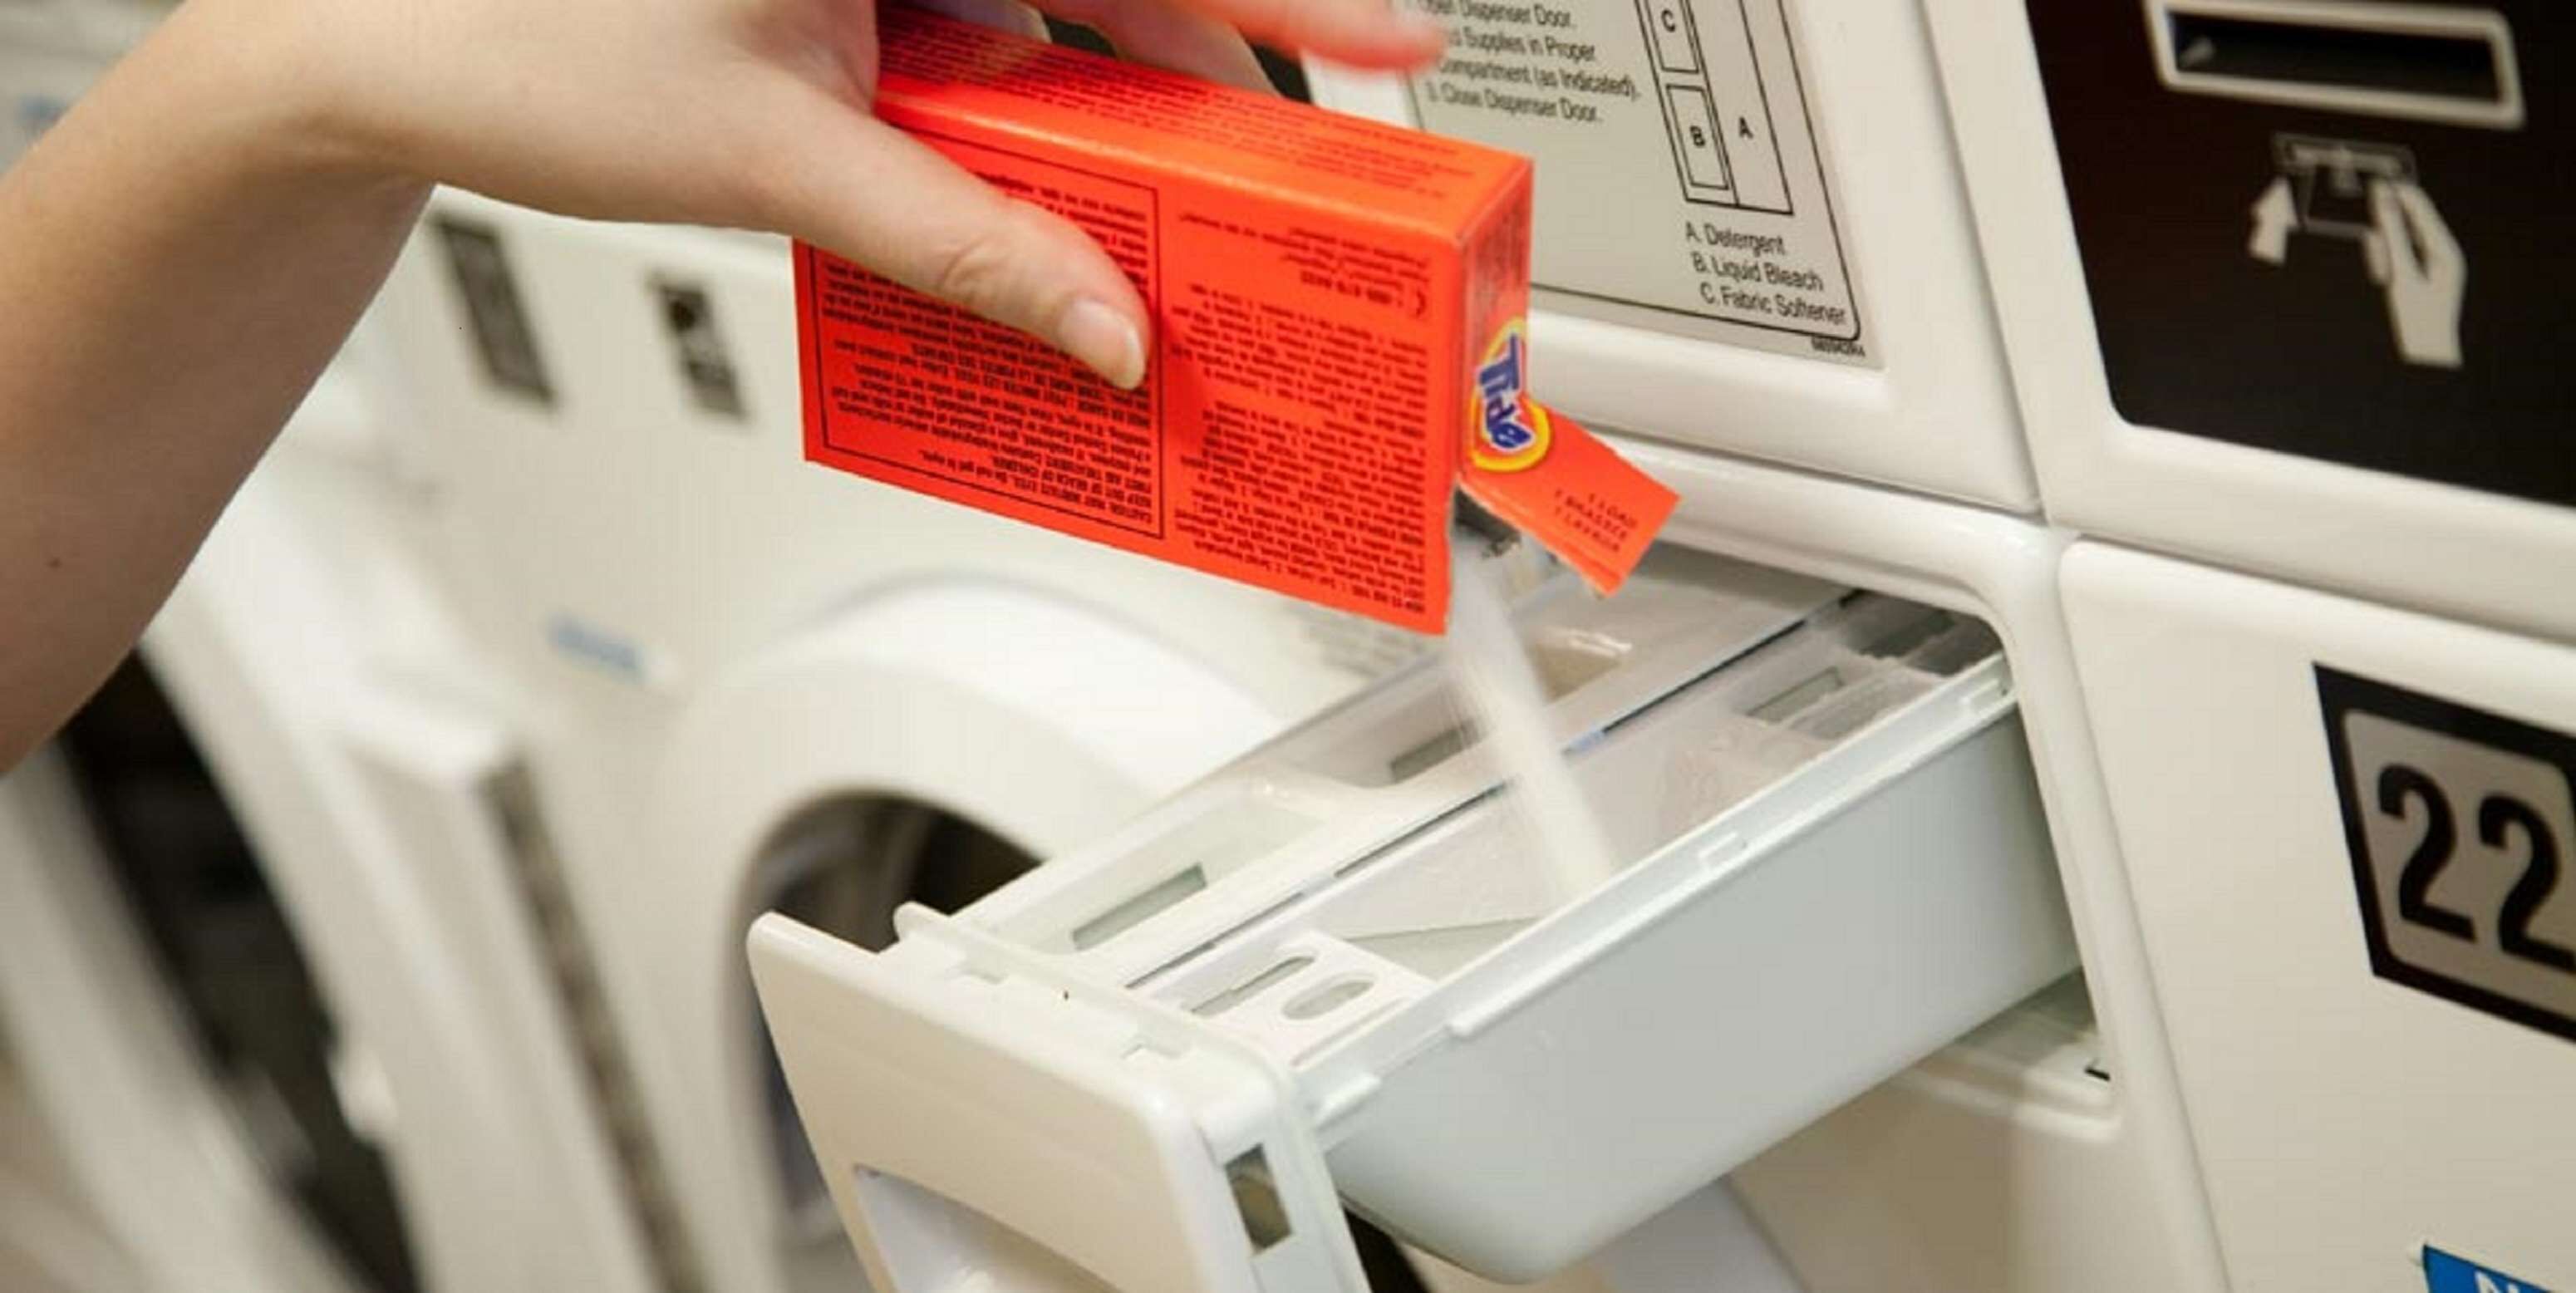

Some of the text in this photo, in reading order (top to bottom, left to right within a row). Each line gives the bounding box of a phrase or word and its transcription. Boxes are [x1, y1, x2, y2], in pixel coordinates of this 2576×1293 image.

[1661, 9, 1676, 32] C
[1528, 38, 1543, 56] in
[1545, 36, 1595, 64] Proper
[1440, 81, 1484, 107] Close
[1484, 88, 1557, 116] Dispenser
[1689, 125, 1706, 148] B
[1739, 116, 1753, 139] A
[1703, 222, 1787, 258] Detergent
[1691, 251, 1825, 293] B. Liquid Bleach
[1700, 281, 1846, 327] C. Fabric Softener
[2378, 763, 2576, 974] 22
